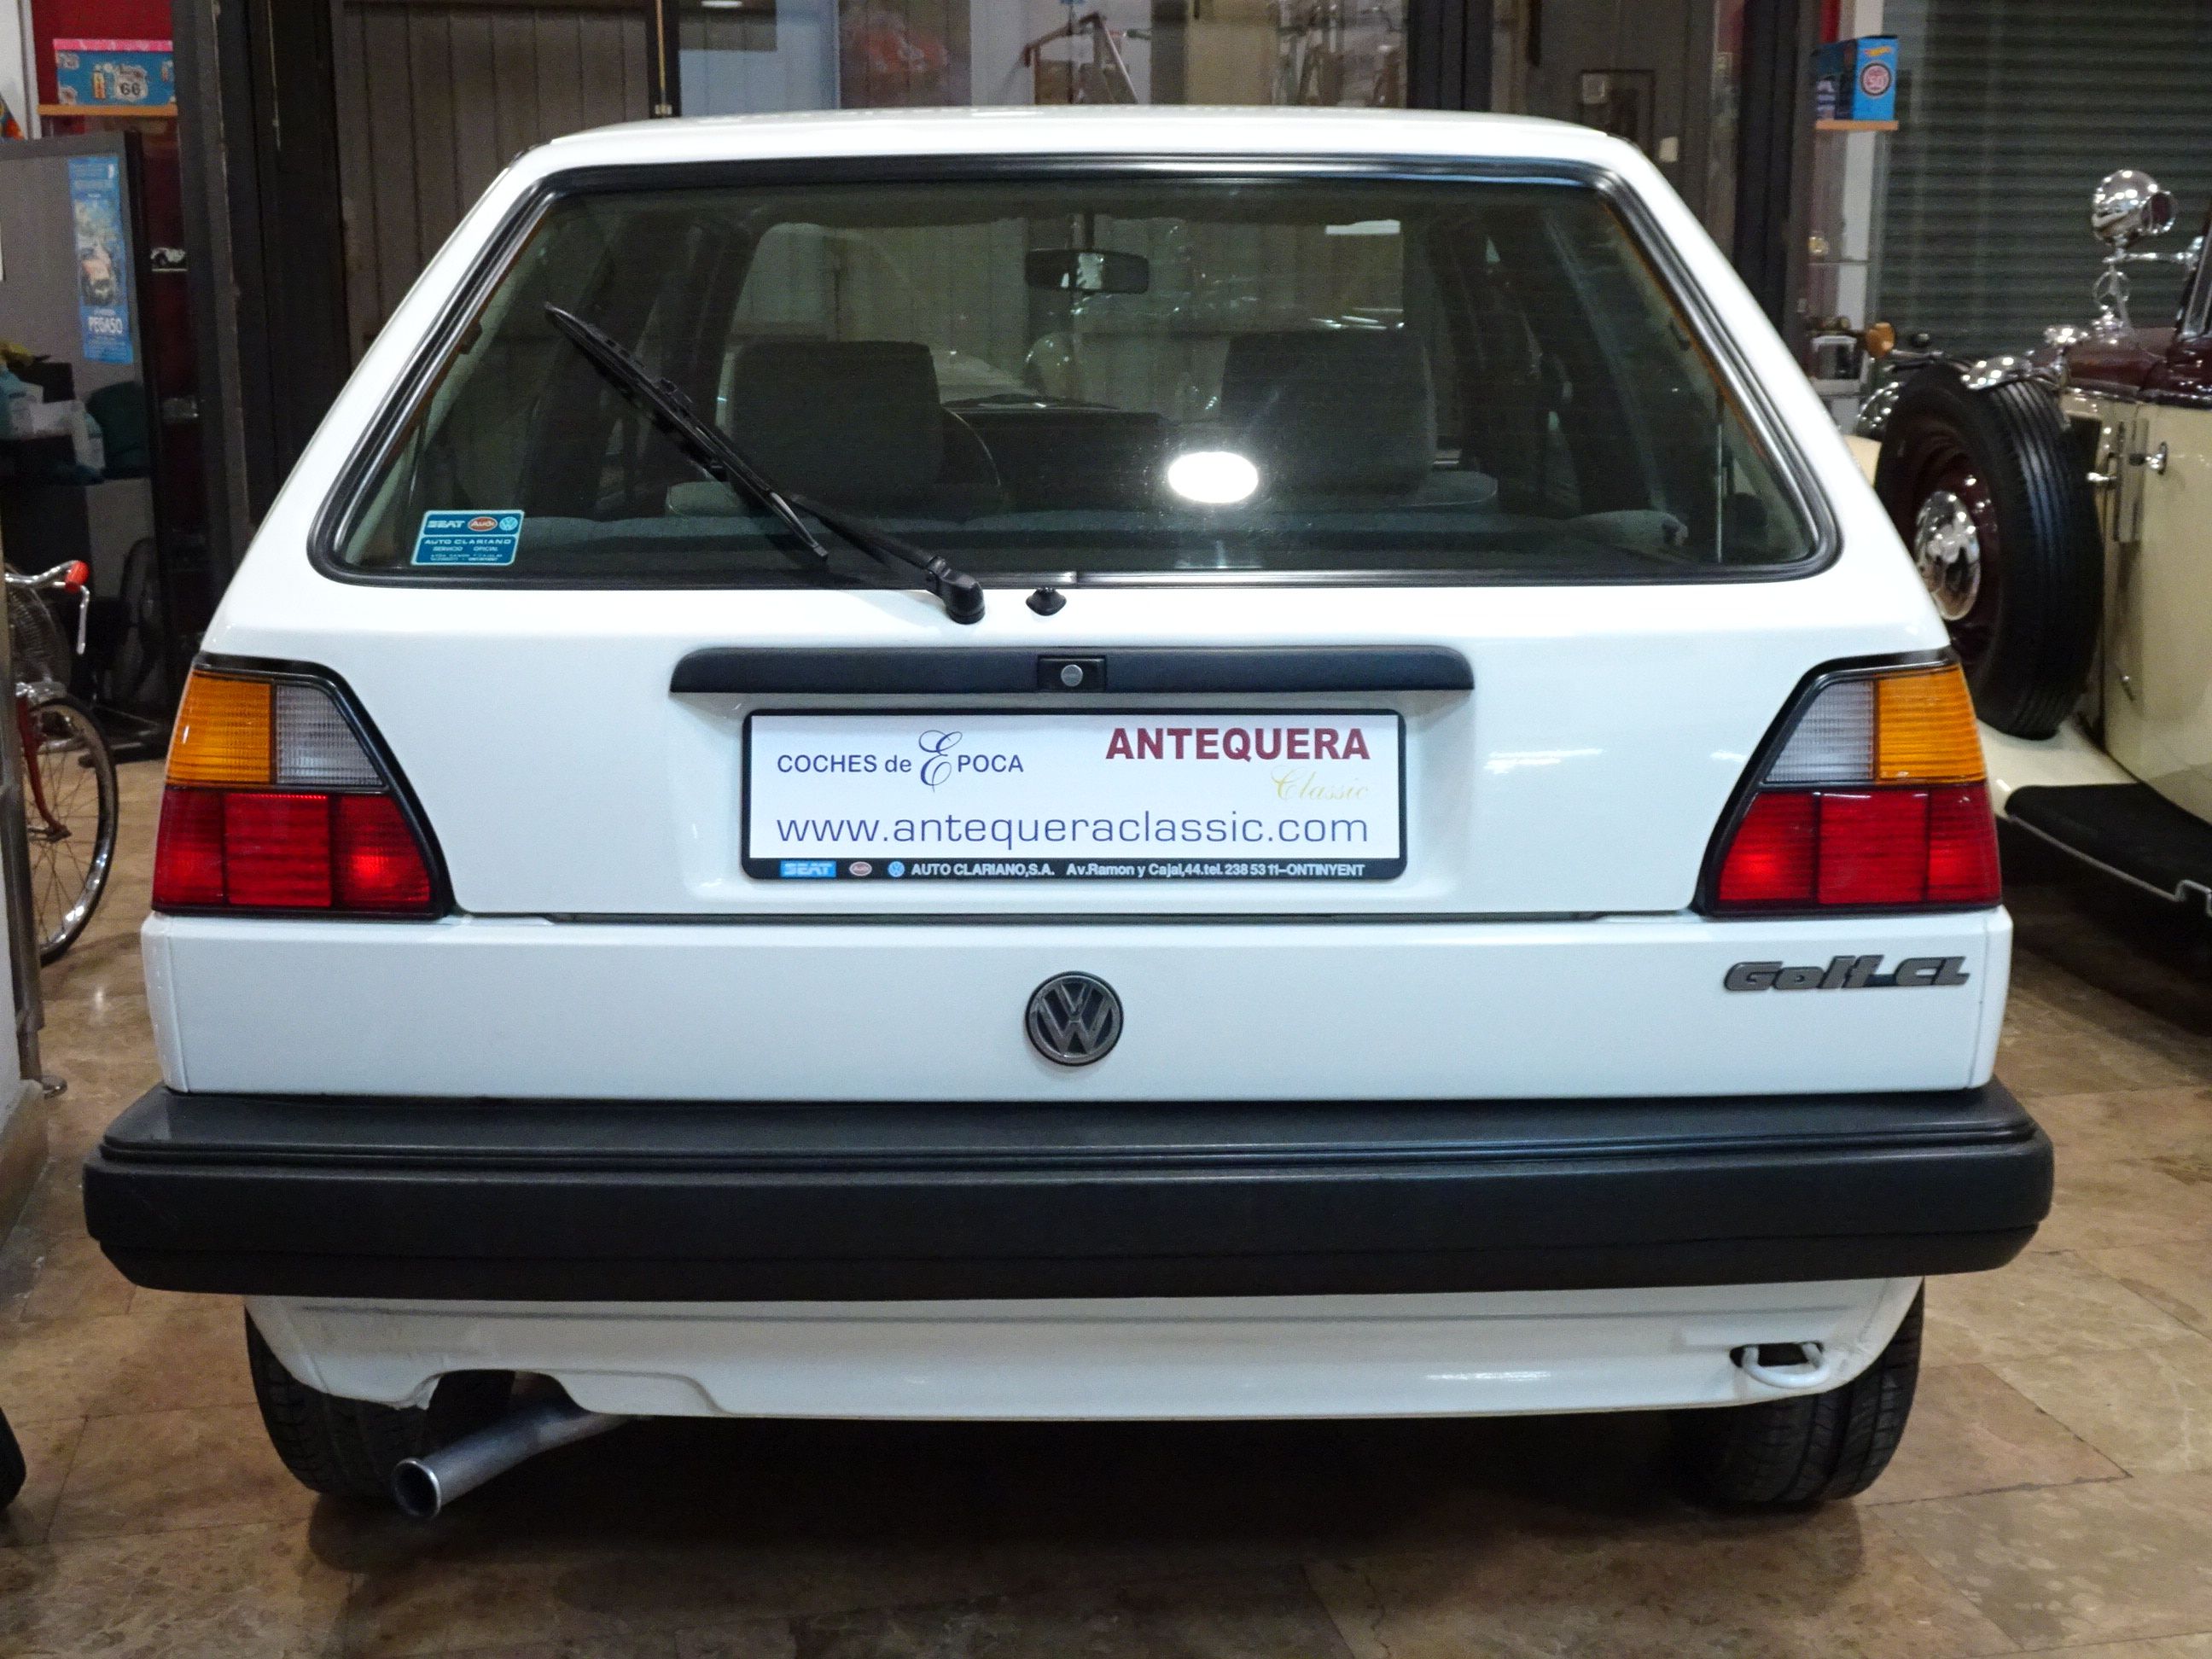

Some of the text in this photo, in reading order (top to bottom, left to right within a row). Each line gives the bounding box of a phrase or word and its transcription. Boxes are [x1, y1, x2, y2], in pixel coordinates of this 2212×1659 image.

[119, 82, 141, 96] 66
[428, 520, 465, 528] SEAT
[1105, 727, 1371, 762] ANTEQUERA
[777, 754, 877, 772] COCHES
[884, 754, 911, 772] de
[1272, 765, 1369, 800] Classic
[777, 811, 1367, 850] www.antequeraclassic.com
[784, 863, 832, 876] SEAT
[911, 864, 951, 876] AUTO
[1137, 865, 1146, 878] y
